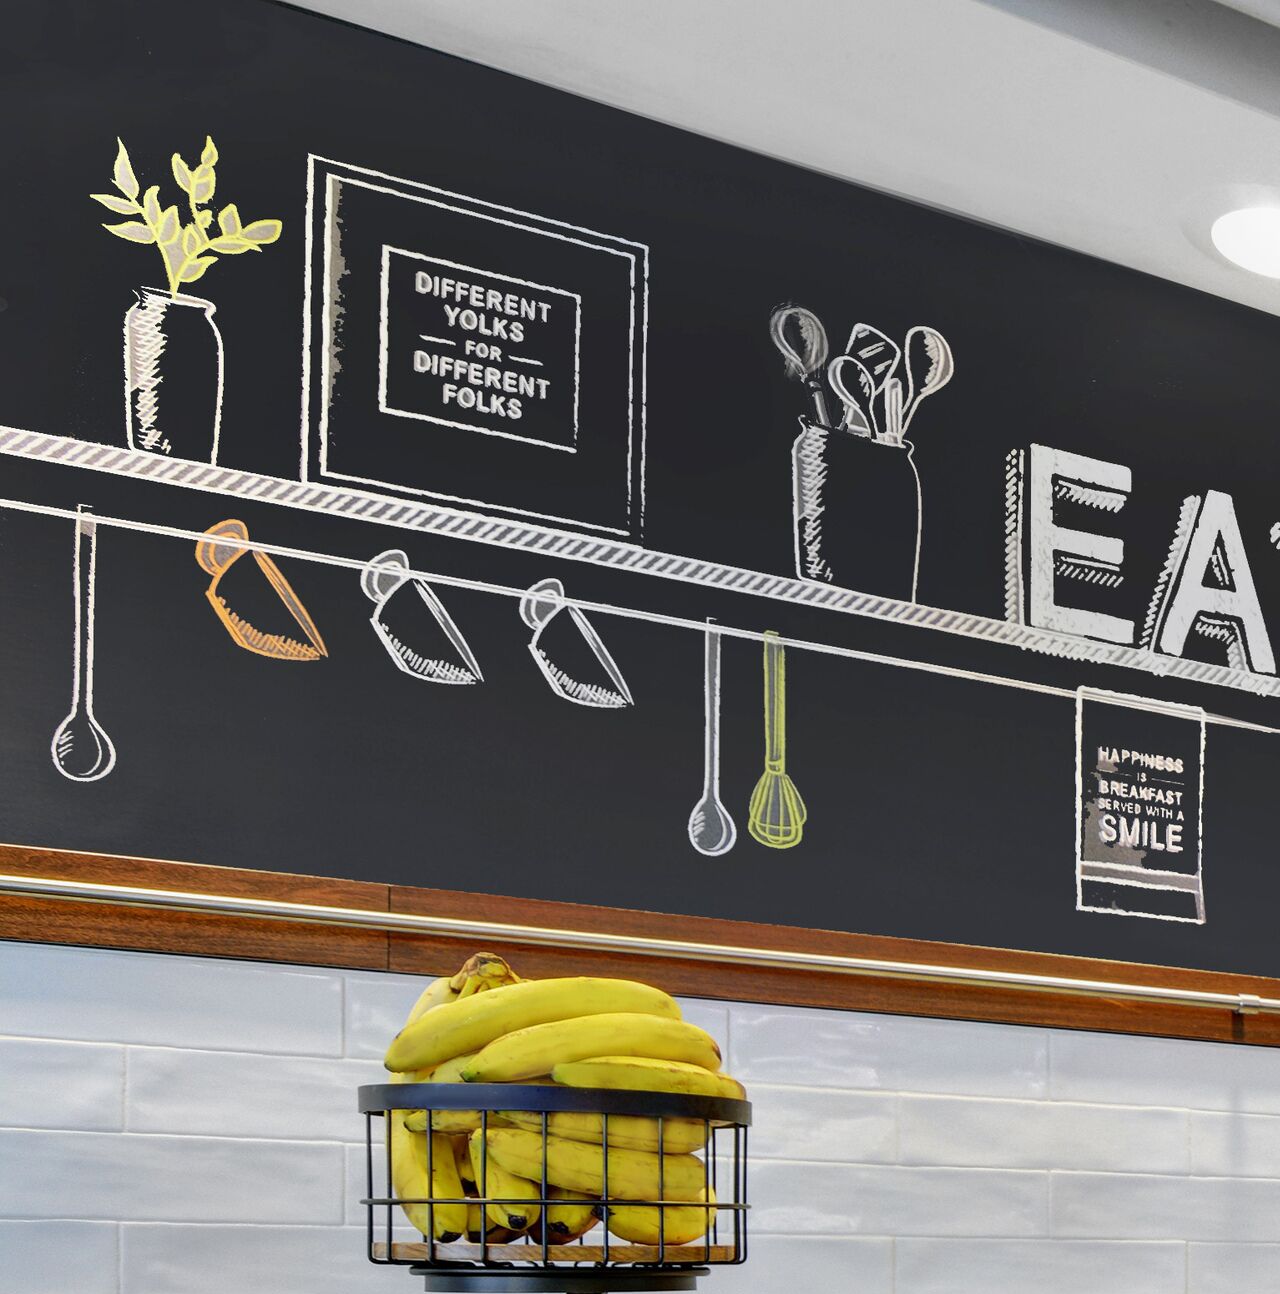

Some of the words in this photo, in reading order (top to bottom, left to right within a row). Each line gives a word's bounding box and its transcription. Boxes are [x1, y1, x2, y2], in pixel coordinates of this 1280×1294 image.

[415, 271, 551, 323] DIFFERENT
[444, 304, 524, 343] YOLKS
[465, 340, 502, 362] FOR
[413, 350, 550, 400] DIFFERENT
[442, 383, 522, 420] FOLKS
[1098, 746, 1184, 773] HAPPINESS
[1099, 780, 1183, 806] BREAKFAST
[1136, 772, 1147, 782] IS
[1098, 798, 1141, 815] SERVED
[1145, 805, 1173, 820] WITH
[1176, 810, 1185, 821] A
[1099, 813, 1184, 853] SMILE
